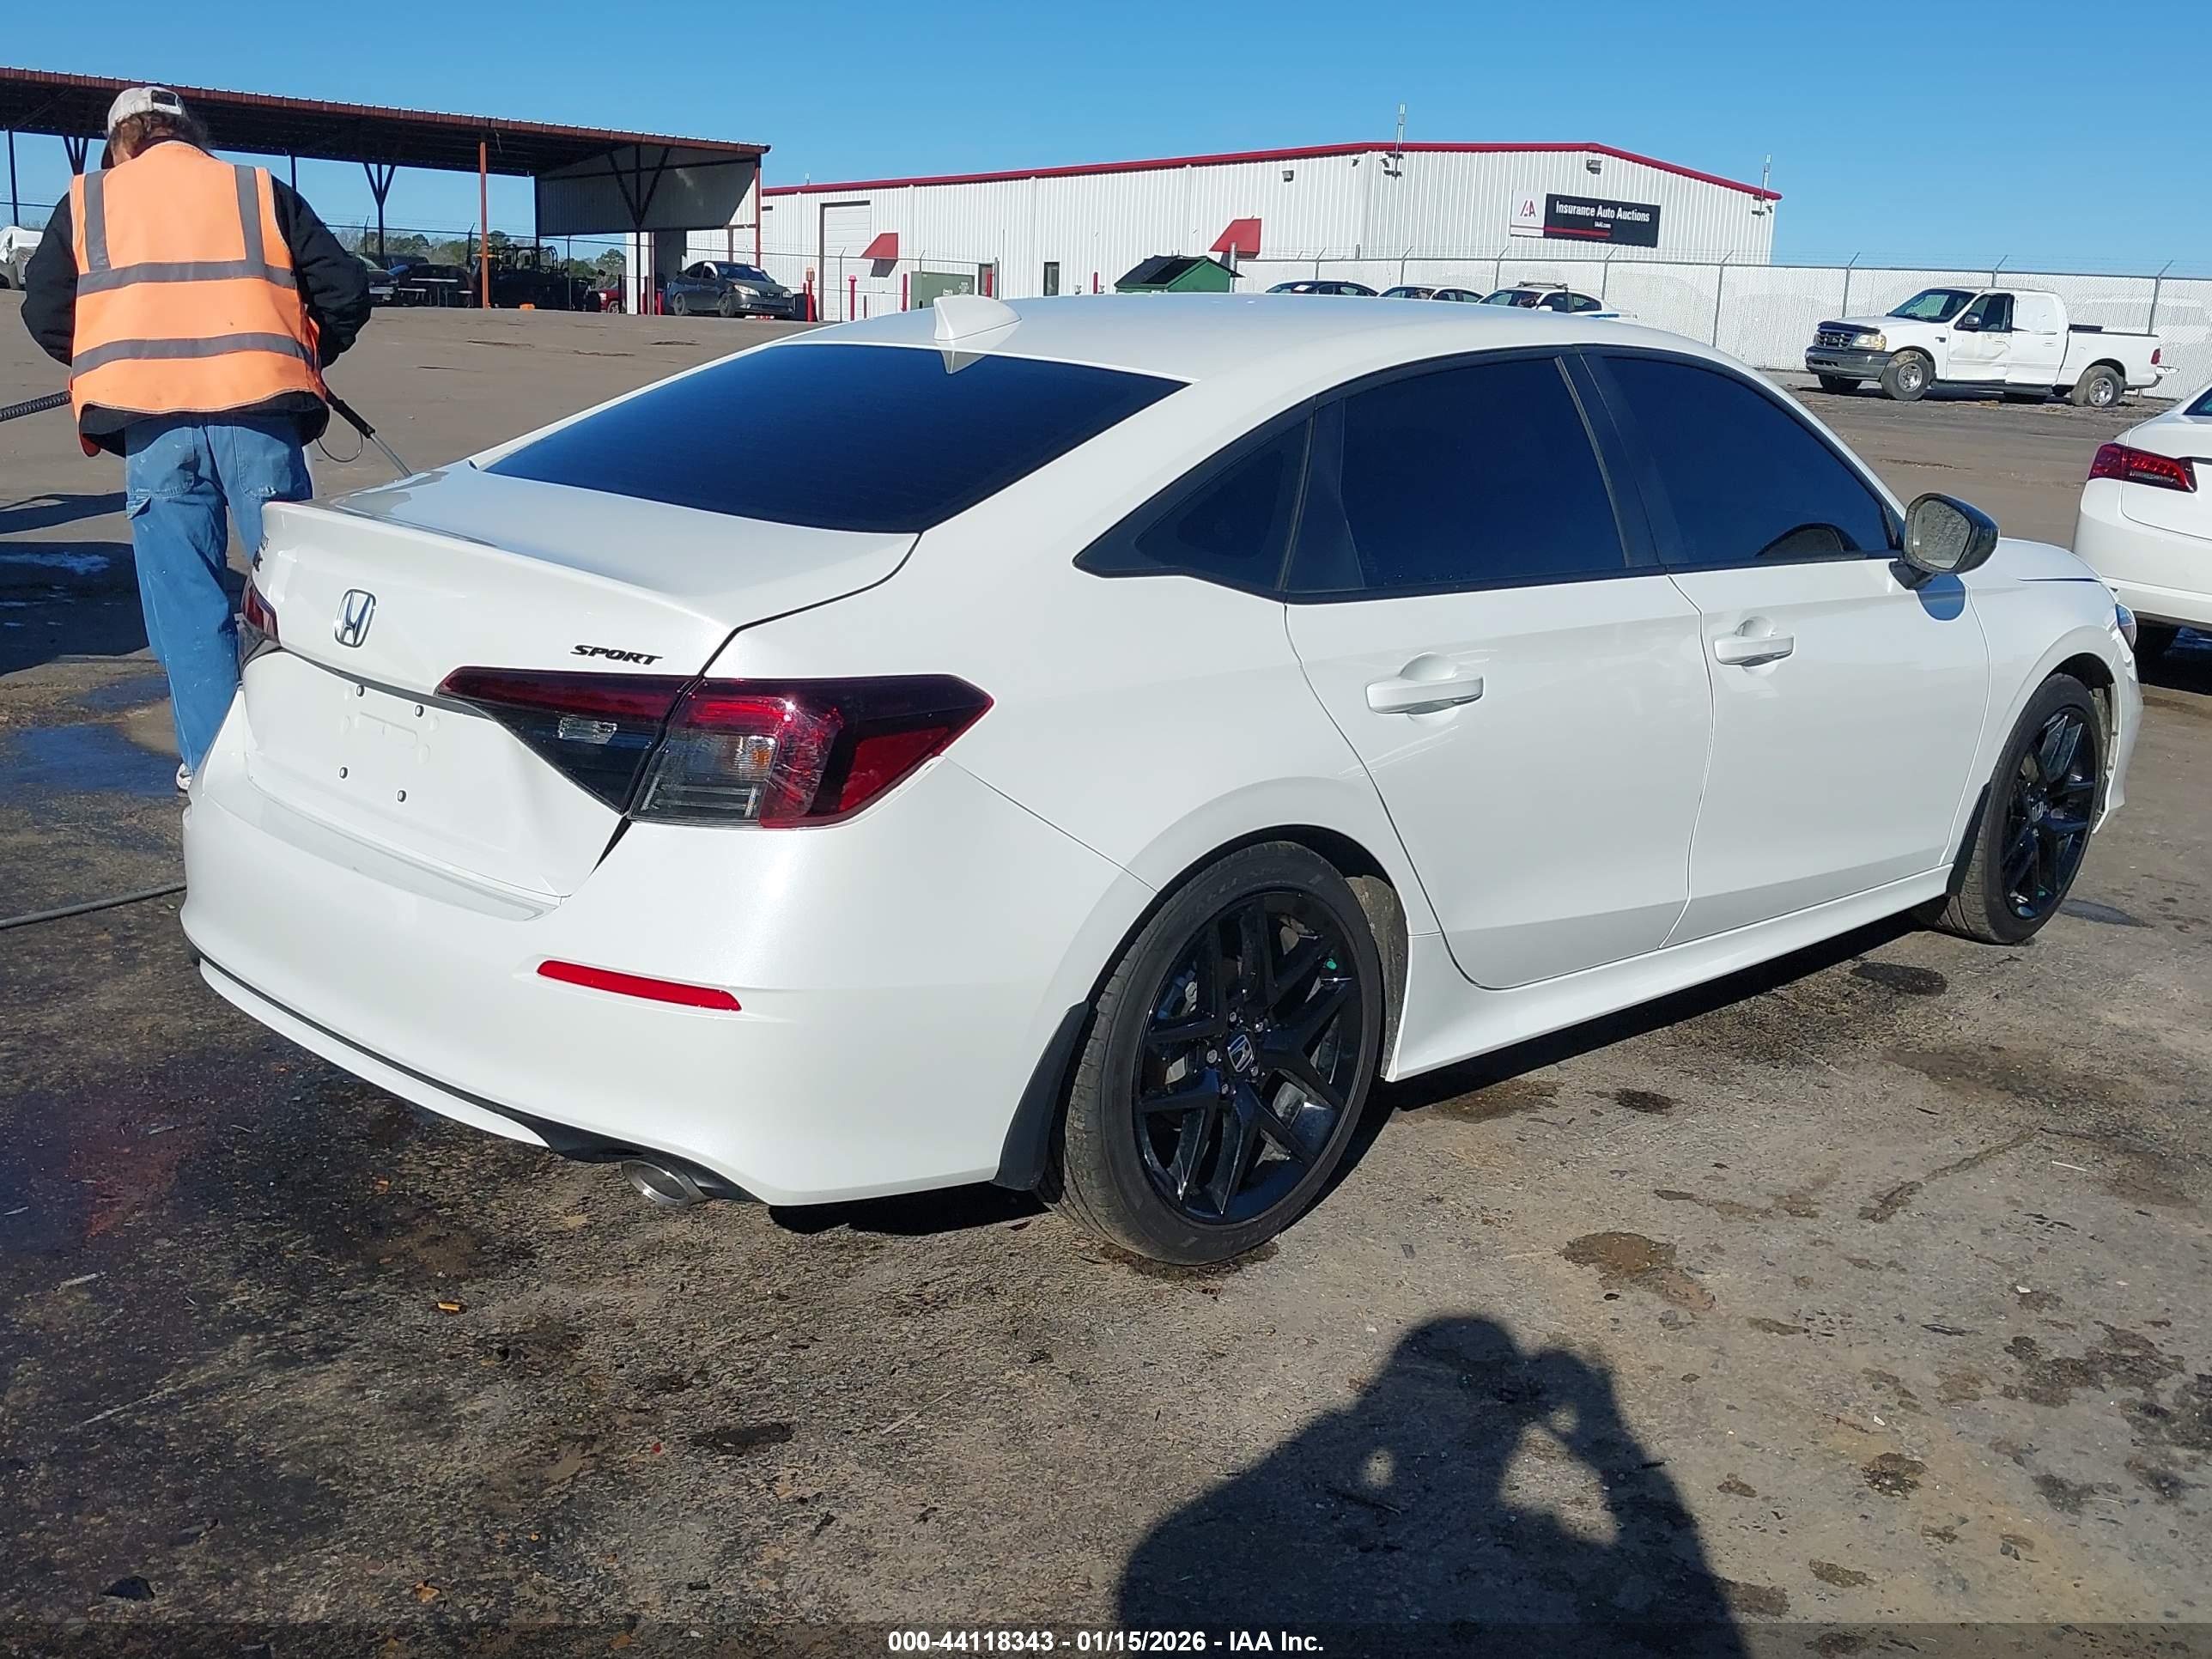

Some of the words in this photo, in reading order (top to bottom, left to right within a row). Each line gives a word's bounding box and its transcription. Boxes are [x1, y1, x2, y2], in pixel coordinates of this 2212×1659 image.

[1555, 200, 1595, 216] Insurance
[1596, 204, 1615, 219] Auto
[1616, 206, 1650, 222] Auctions
[569, 644, 664, 665] SPORT
